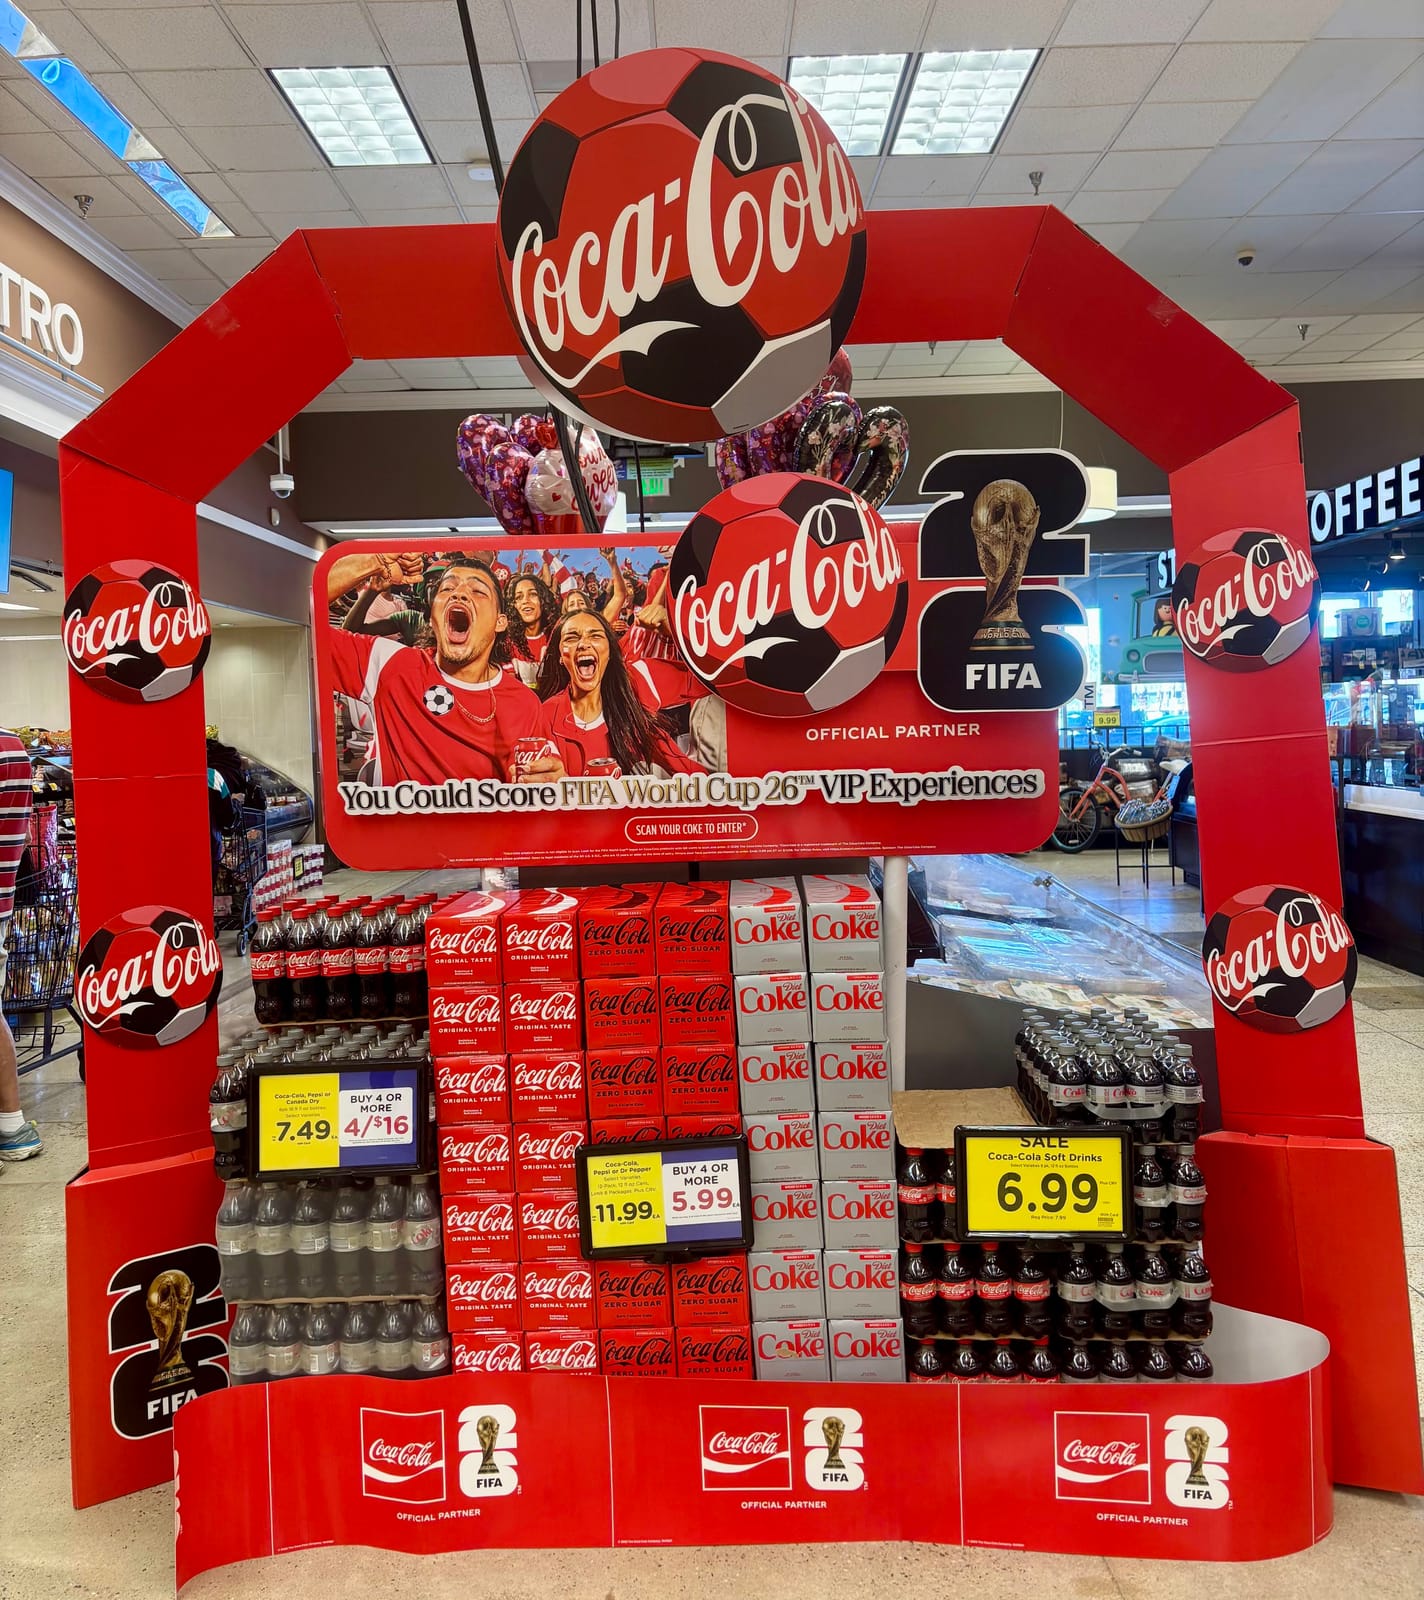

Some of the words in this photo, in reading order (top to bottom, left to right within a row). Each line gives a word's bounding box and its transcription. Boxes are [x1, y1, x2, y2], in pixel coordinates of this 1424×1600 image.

[512, 83, 858, 388] Coca-Cola
[1306, 457, 1421, 543] OFFEE
[675, 492, 902, 680] Coca-Cola
[1177, 534, 1316, 656] Coca-Cola
[64, 579, 208, 673] Coca-Cola
[966, 663, 1042, 690] FIFA
[1084, 685, 1094, 709] TM
[1098, 716, 1118, 725] 9.99
[806, 726, 889, 741] OFFICIAL
[895, 723, 981, 738] PARTNER
[342, 784, 390, 810] You
[395, 782, 472, 808] Could
[479, 783, 556, 807] Score
[561, 781, 619, 806] FIFA
[621, 775, 700, 805] World
[705, 778, 760, 805] Cup
[820, 773, 866, 799] VIP
[870, 769, 1037, 803] Experiences
[636, 824, 658, 835] SCAN
[659, 823, 681, 835] YOUR
[683, 823, 704, 835] COKE
[705, 823, 716, 834] TO
[776, 912, 796, 922] Diet
[856, 911, 876, 920] Diet
[734, 916, 800, 945] Coke
[812, 914, 880, 941] Coke
[1207, 893, 1349, 1011] Coca-Cola
[78, 919, 221, 1028] Coca-Cola
[783, 982, 802, 991] Diet
[859, 981, 879, 990] Diet
[739, 985, 807, 1014] Coke
[815, 984, 883, 1011] Coke
[622, 1018, 652, 1026] SUGAR
[786, 1051, 805, 1060] Diet
[863, 1050, 883, 1060] Diet
[742, 1055, 809, 1083] Coke
[820, 1053, 888, 1080] Coke
[350, 1095, 373, 1103] BUY
[376, 1094, 383, 1102] 4
[386, 1093, 402, 1102] OR
[360, 1104, 392, 1112] MORE
[276, 1119, 331, 1142] 7.49
[344, 1115, 409, 1138] 4/$16
[790, 1120, 810, 1129] Diet
[866, 1120, 887, 1130] Diet
[746, 1124, 814, 1151] Coke
[823, 1123, 891, 1150] Coke
[1020, 1137, 1069, 1148] SALE
[988, 1152, 1041, 1161] Coca-Cola
[1044, 1152, 1066, 1161] Soft
[1069, 1153, 1102, 1162] Drinks
[673, 1165, 696, 1176] BUY
[700, 1165, 707, 1173] 4
[711, 1163, 728, 1173] OR
[684, 1176, 718, 1186] MORE
[672, 1187, 733, 1212] 5.99
[793, 1191, 813, 1200] Diet
[871, 1191, 891, 1199] Diet
[997, 1172, 1099, 1213] 6.99
[595, 1201, 653, 1222] 11.99
[751, 1193, 817, 1221] Coke
[827, 1193, 894, 1220] Coke
[796, 1261, 815, 1270] Diet
[872, 1260, 892, 1269] Diet
[752, 1264, 820, 1291] Coke
[828, 1263, 896, 1290] Coke
[801, 1329, 821, 1338] Diet
[877, 1329, 897, 1338] Diet
[833, 1331, 901, 1358] Coke
[369, 1438, 435, 1467] Coca-Cola
[709, 1431, 781, 1454] Coca-Cola
[1063, 1439, 1140, 1466] Coca-Cola
[476, 1477, 503, 1488] FIFA
[822, 1473, 849, 1482] FIFA
[741, 1501, 782, 1509] OFFICIAL
[785, 1501, 827, 1509] PARTNER
[1184, 1489, 1213, 1500] FIFA
[396, 1512, 436, 1522] OFFICIAL
[438, 1508, 481, 1520] PARTNER
[1096, 1513, 1140, 1523] OFFICIAL
[1143, 1516, 1188, 1526] PARTNER
